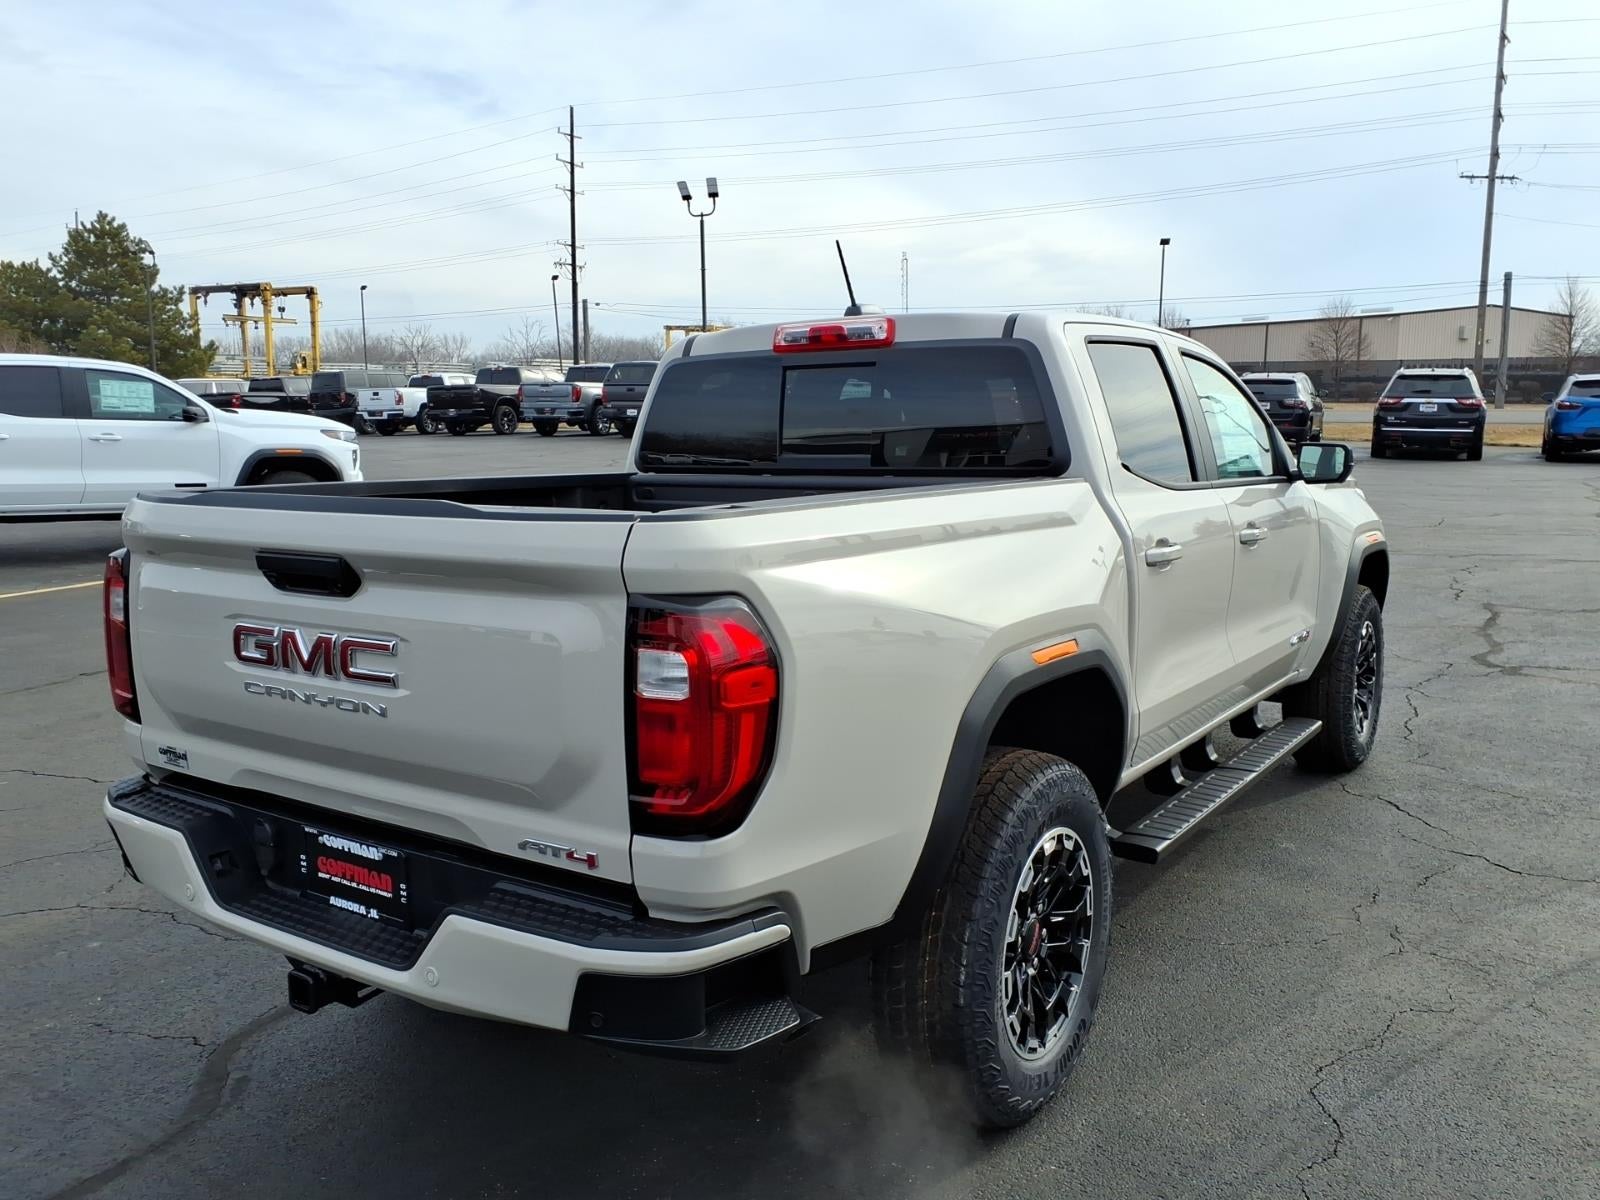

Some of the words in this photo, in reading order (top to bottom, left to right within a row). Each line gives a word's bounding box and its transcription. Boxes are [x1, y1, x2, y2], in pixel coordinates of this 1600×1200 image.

[233, 623, 400, 689] GMC
[244, 680, 388, 718] CANYON
[322, 834, 380, 860] COFFMAN
[518, 838, 599, 871] AT4
[317, 856, 392, 892] COFFMAN
[329, 896, 367, 915] AURORA
